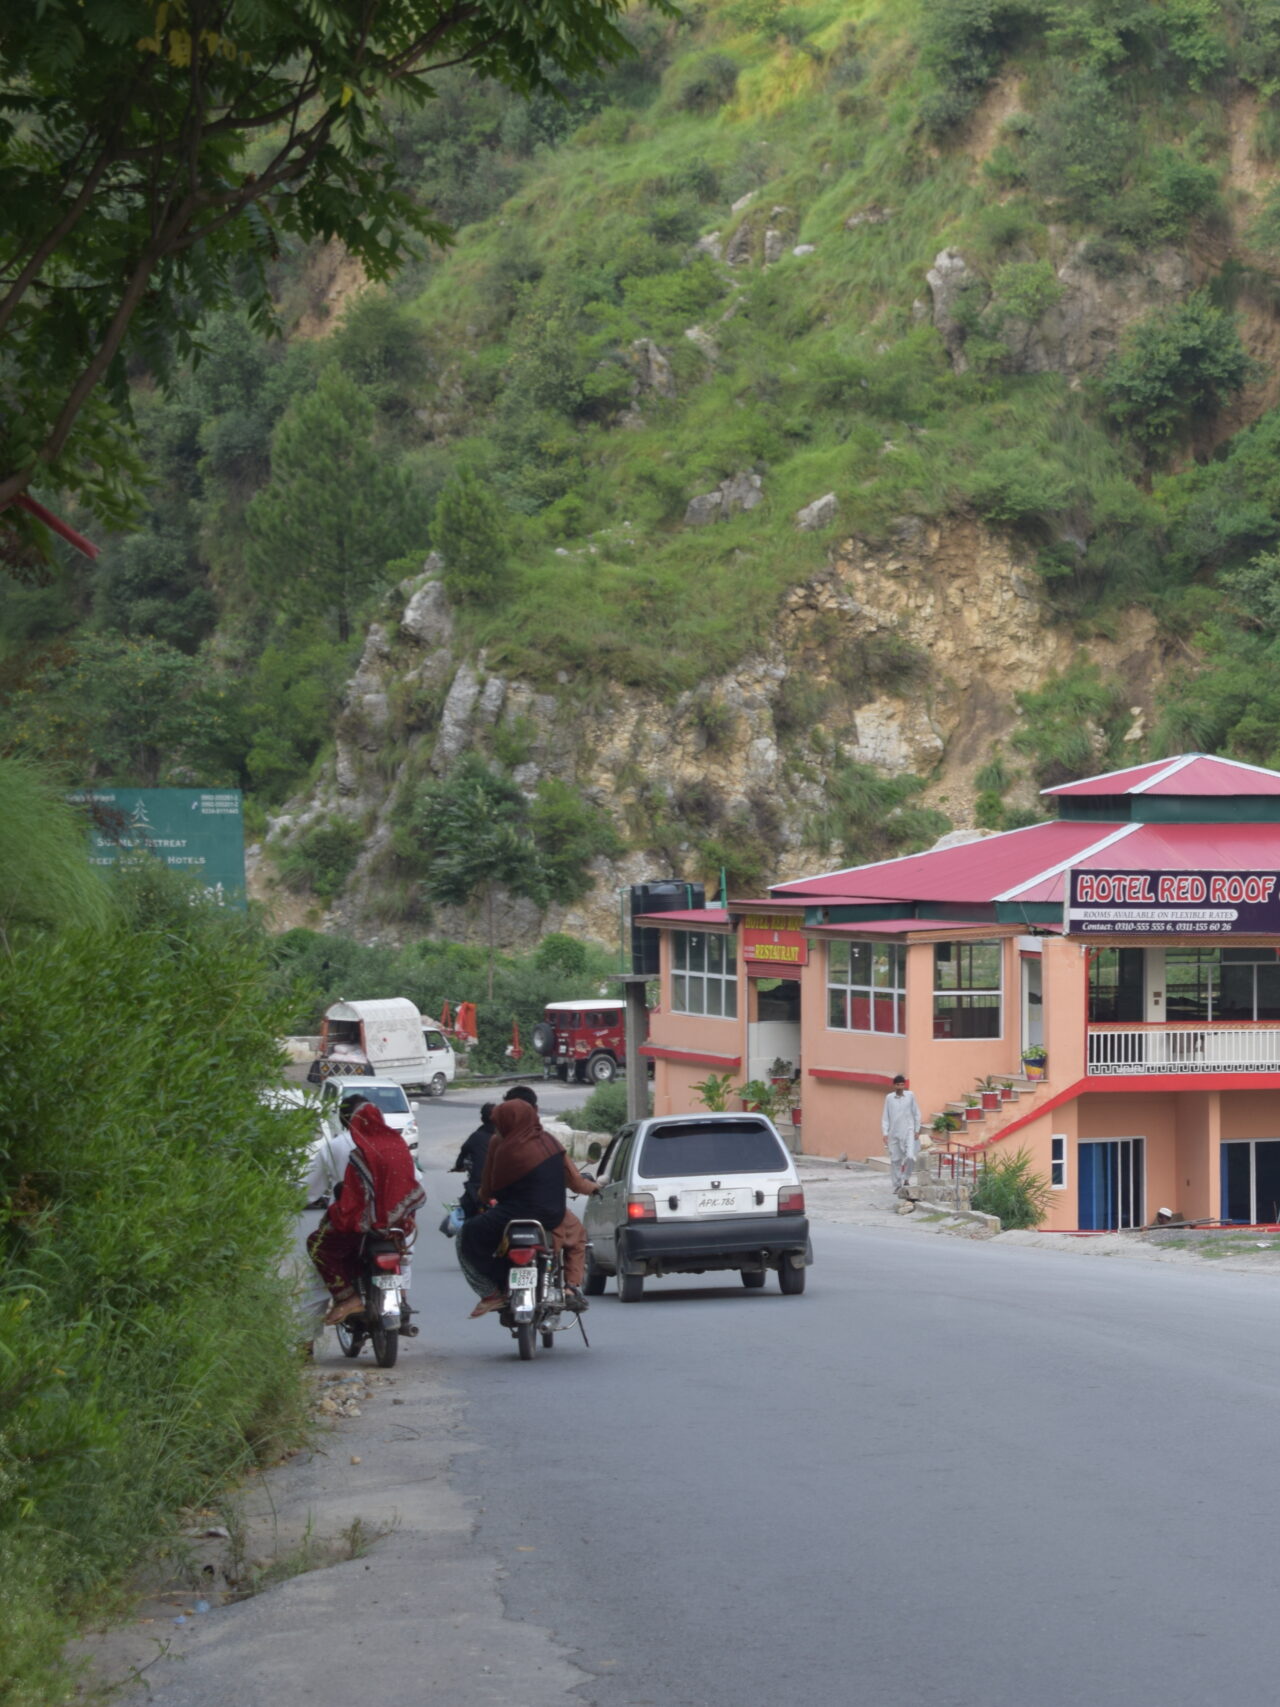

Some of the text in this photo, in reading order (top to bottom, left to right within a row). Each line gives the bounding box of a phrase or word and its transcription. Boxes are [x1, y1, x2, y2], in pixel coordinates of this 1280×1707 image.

[1077, 875, 1155, 903] HOTEL
[1158, 876, 1206, 903] RED
[1210, 876, 1276, 903] ROOF
[1083, 911, 1234, 919] ROOMS AVAILABLE ON FLEXIBLE RATES
[1082, 922, 1114, 931] Contact:
[1151, 922, 1165, 931] 555
[1209, 922, 1220, 931] 60
[1221, 922, 1232, 931] 26
[755, 944, 799, 961] RESTAURANT
